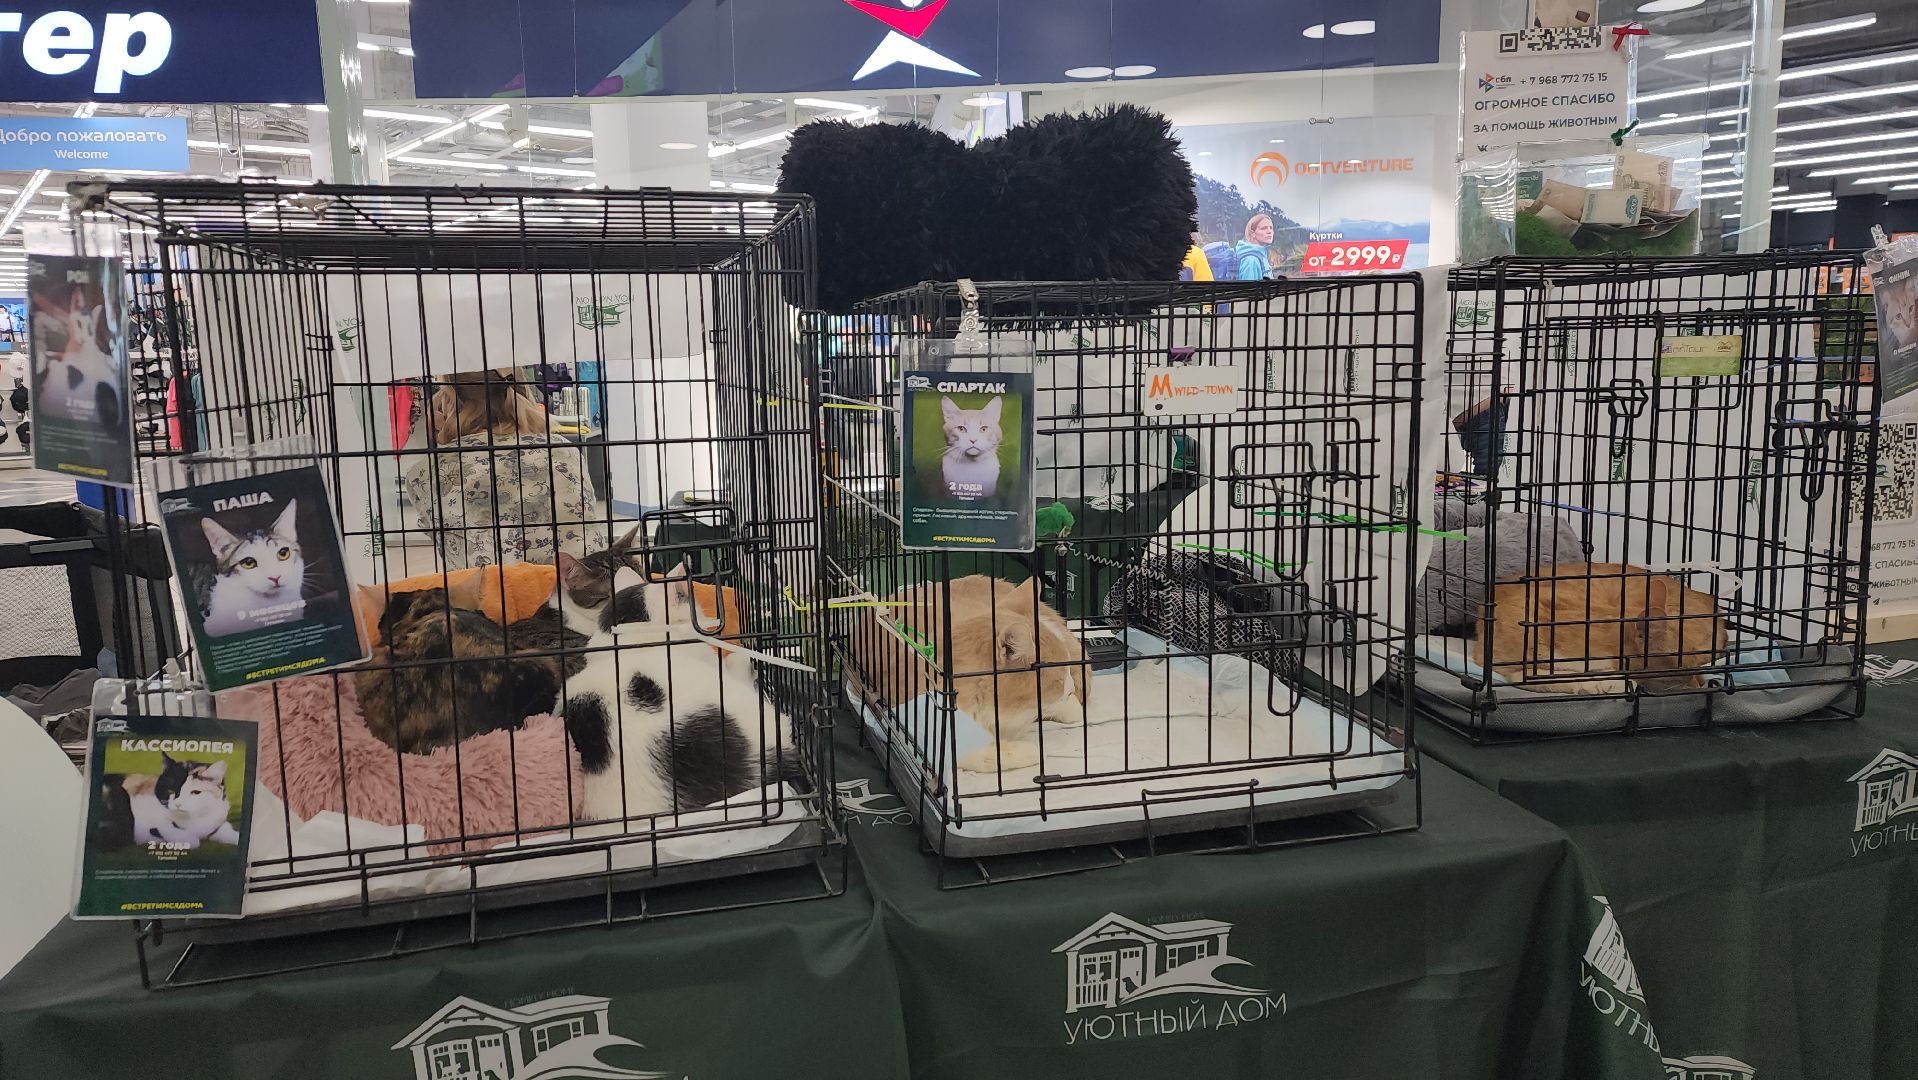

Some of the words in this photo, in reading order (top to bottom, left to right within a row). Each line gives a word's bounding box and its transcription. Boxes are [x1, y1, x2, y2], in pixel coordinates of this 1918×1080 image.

[1529, 76, 1536, 85] 7
[1538, 76, 1558, 85] 968
[1560, 74, 1580, 84] 772
[1582, 73, 1595, 83] 75
[1597, 72, 1608, 82] 15
[1474, 96, 1548, 111] ОГРОМНОЕ
[1552, 92, 1616, 106] СПАСИБО
[1473, 124, 1488, 133] ЗА
[1492, 119, 1545, 132] ПОМОЩЬ
[1548, 115, 1617, 129] ЖИВОТНЫМ
[56, 131, 167, 143] пожаловать
[54, 149, 109, 160] Welcome
[1309, 232, 1343, 243] Куртки
[937, 381, 1006, 394] СПАРТАК
[1174, 385, 1233, 396] WILD-TOWN
[949, 481, 956, 491] 2
[958, 483, 983, 492] года
[212, 491, 274, 513] ПАША
[1882, 541, 1895, 550] 772
[1897, 540, 1907, 549] 75
[1908, 539, 1916, 548] 15
[121, 739, 234, 755] КАССИОПЕЯ
[147, 840, 157, 850] 2
[159, 842, 190, 851] года
[1064, 998, 1207, 1045] УЮТНЫЙ
[1215, 992, 1287, 1031] ДОМ
